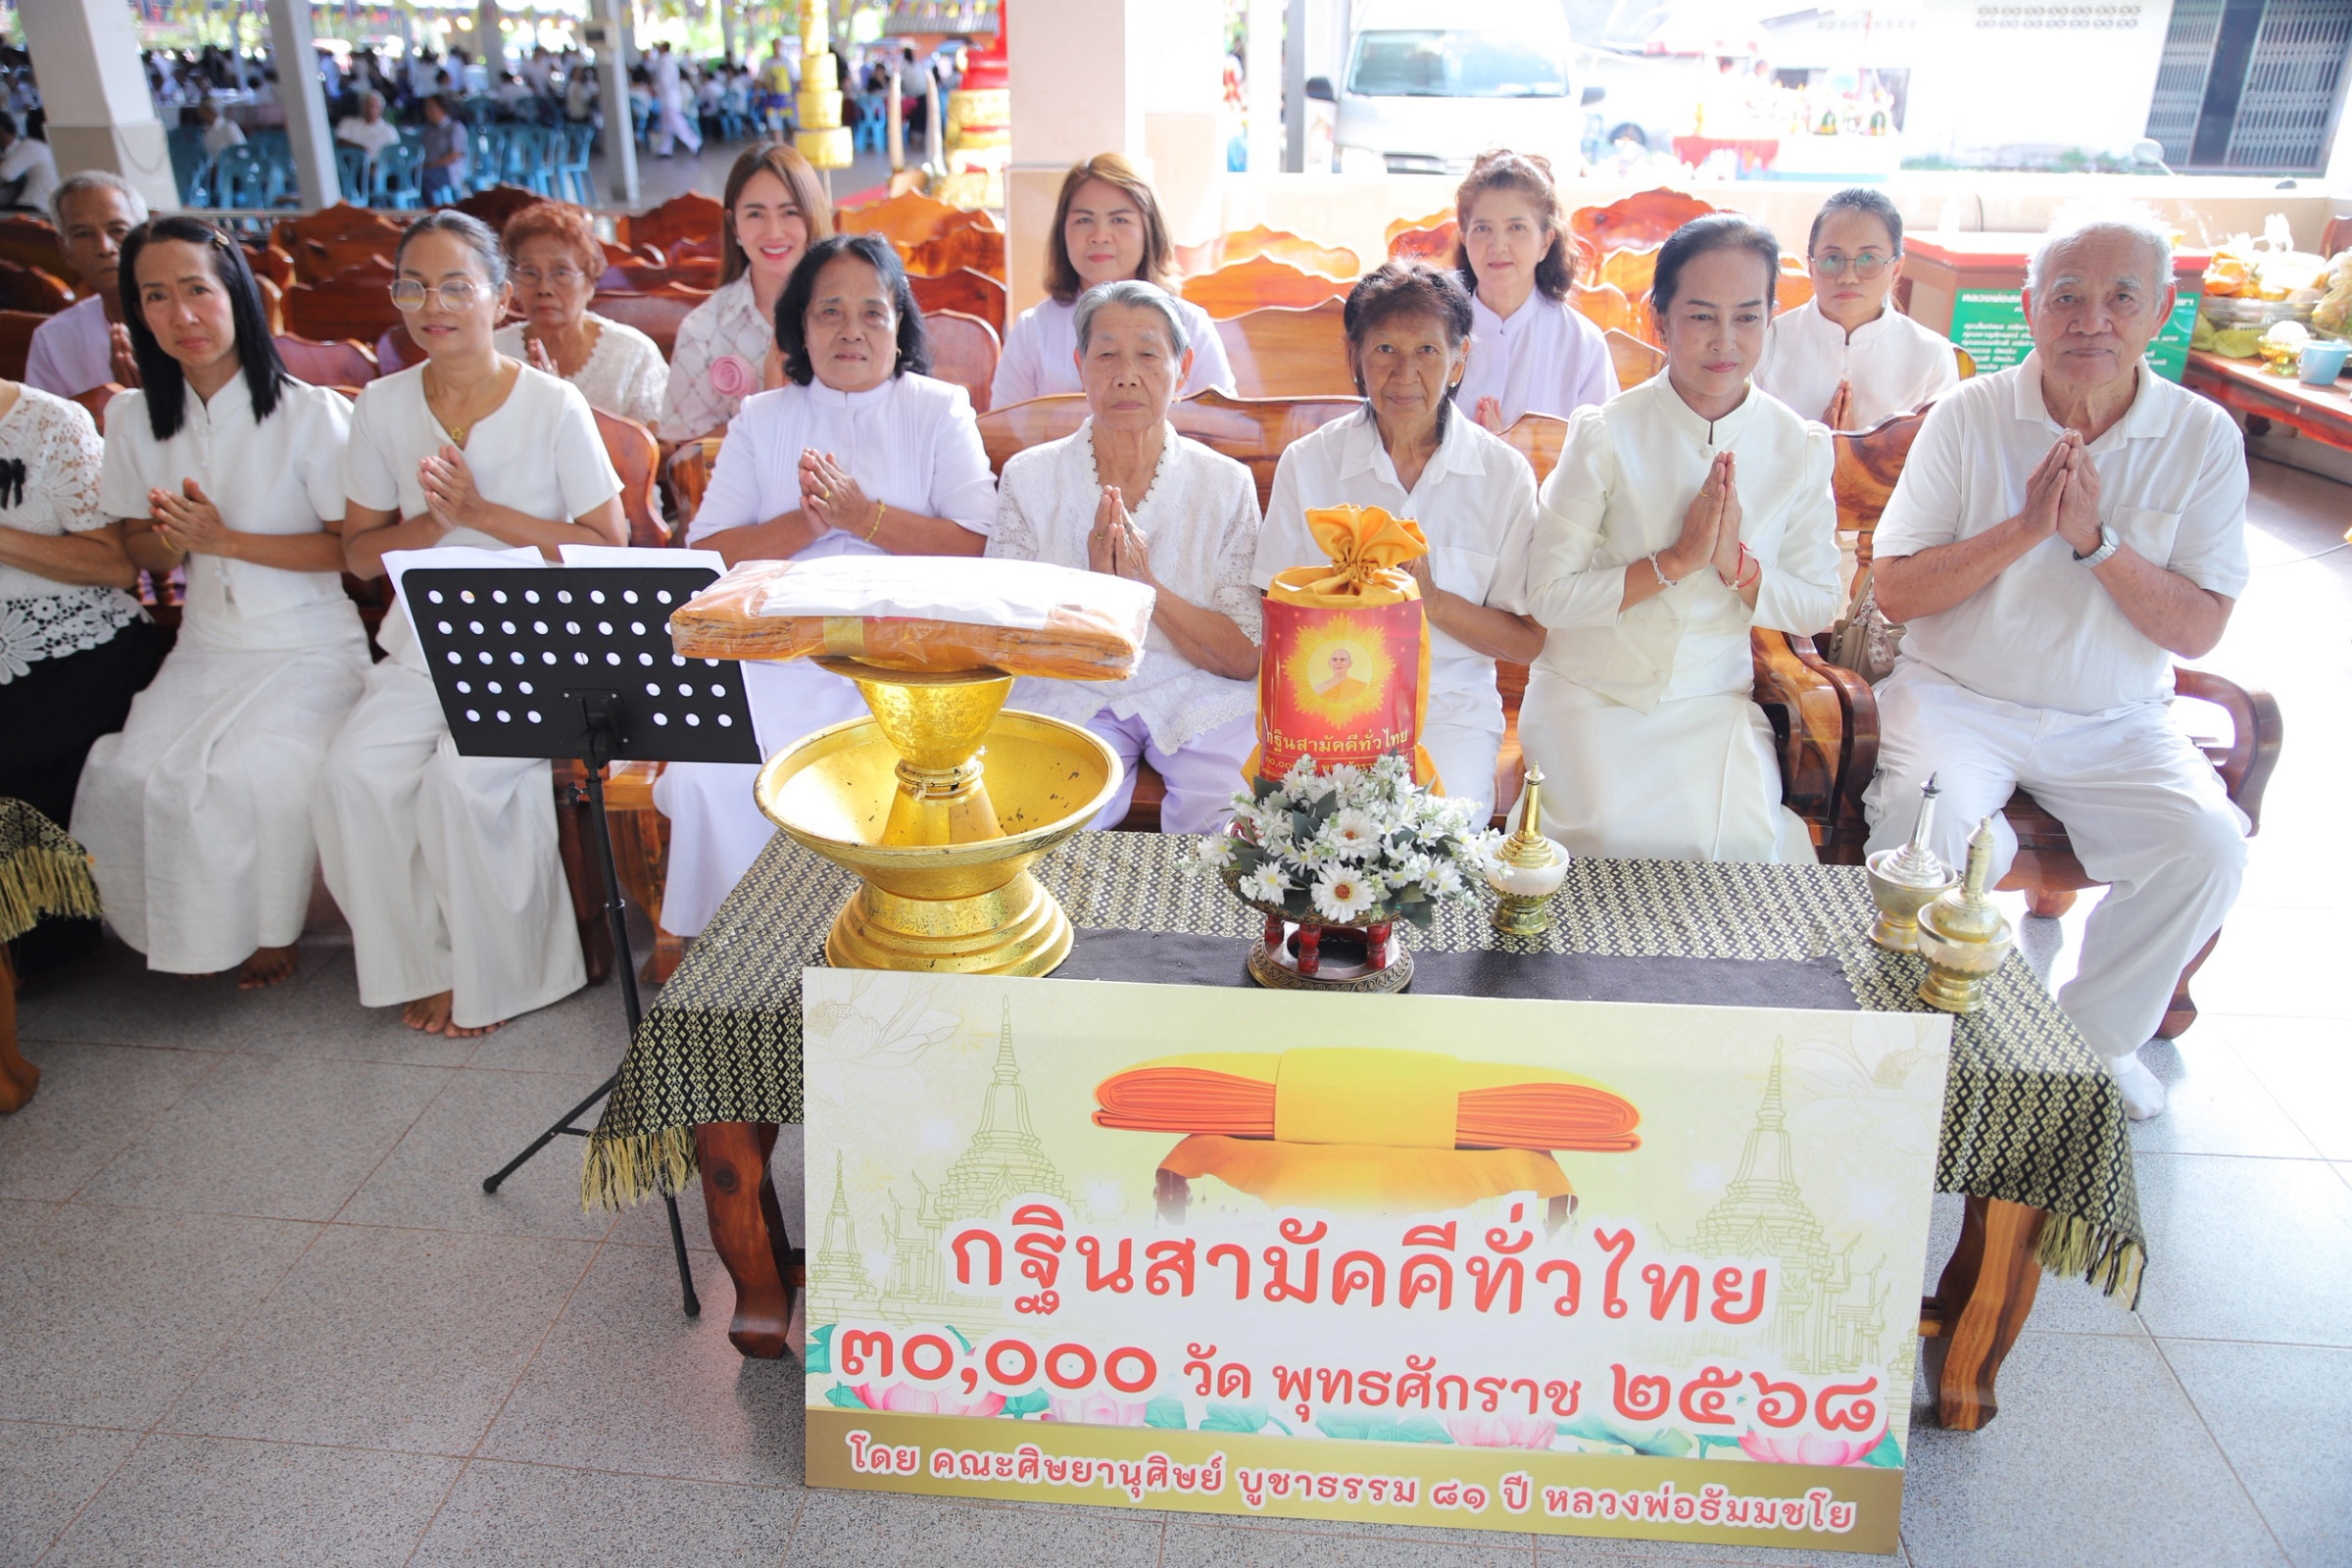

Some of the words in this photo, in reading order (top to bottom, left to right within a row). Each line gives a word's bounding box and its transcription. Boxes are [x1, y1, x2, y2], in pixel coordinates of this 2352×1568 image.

[951, 1202, 1768, 1325] กฐินสามัคคีทั่วไทย
[841, 1328, 1158, 1395] ๓๐,๐๐๐
[1183, 1342, 1252, 1399] วัด
[1271, 1354, 1582, 1423] พุทธศักราช
[1610, 1362, 1879, 1433] ๒๕๖๘
[850, 1434, 917, 1471] โดย
[933, 1446, 1224, 1498] คณะศิษยานุศิษย์
[1239, 1471, 1416, 1506] บูชาธรรม
[1432, 1485, 1487, 1509] ๘๑
[1502, 1475, 1529, 1510] ปี
[1544, 1484, 1853, 1529] หลวงพ่อธัมมชโย
